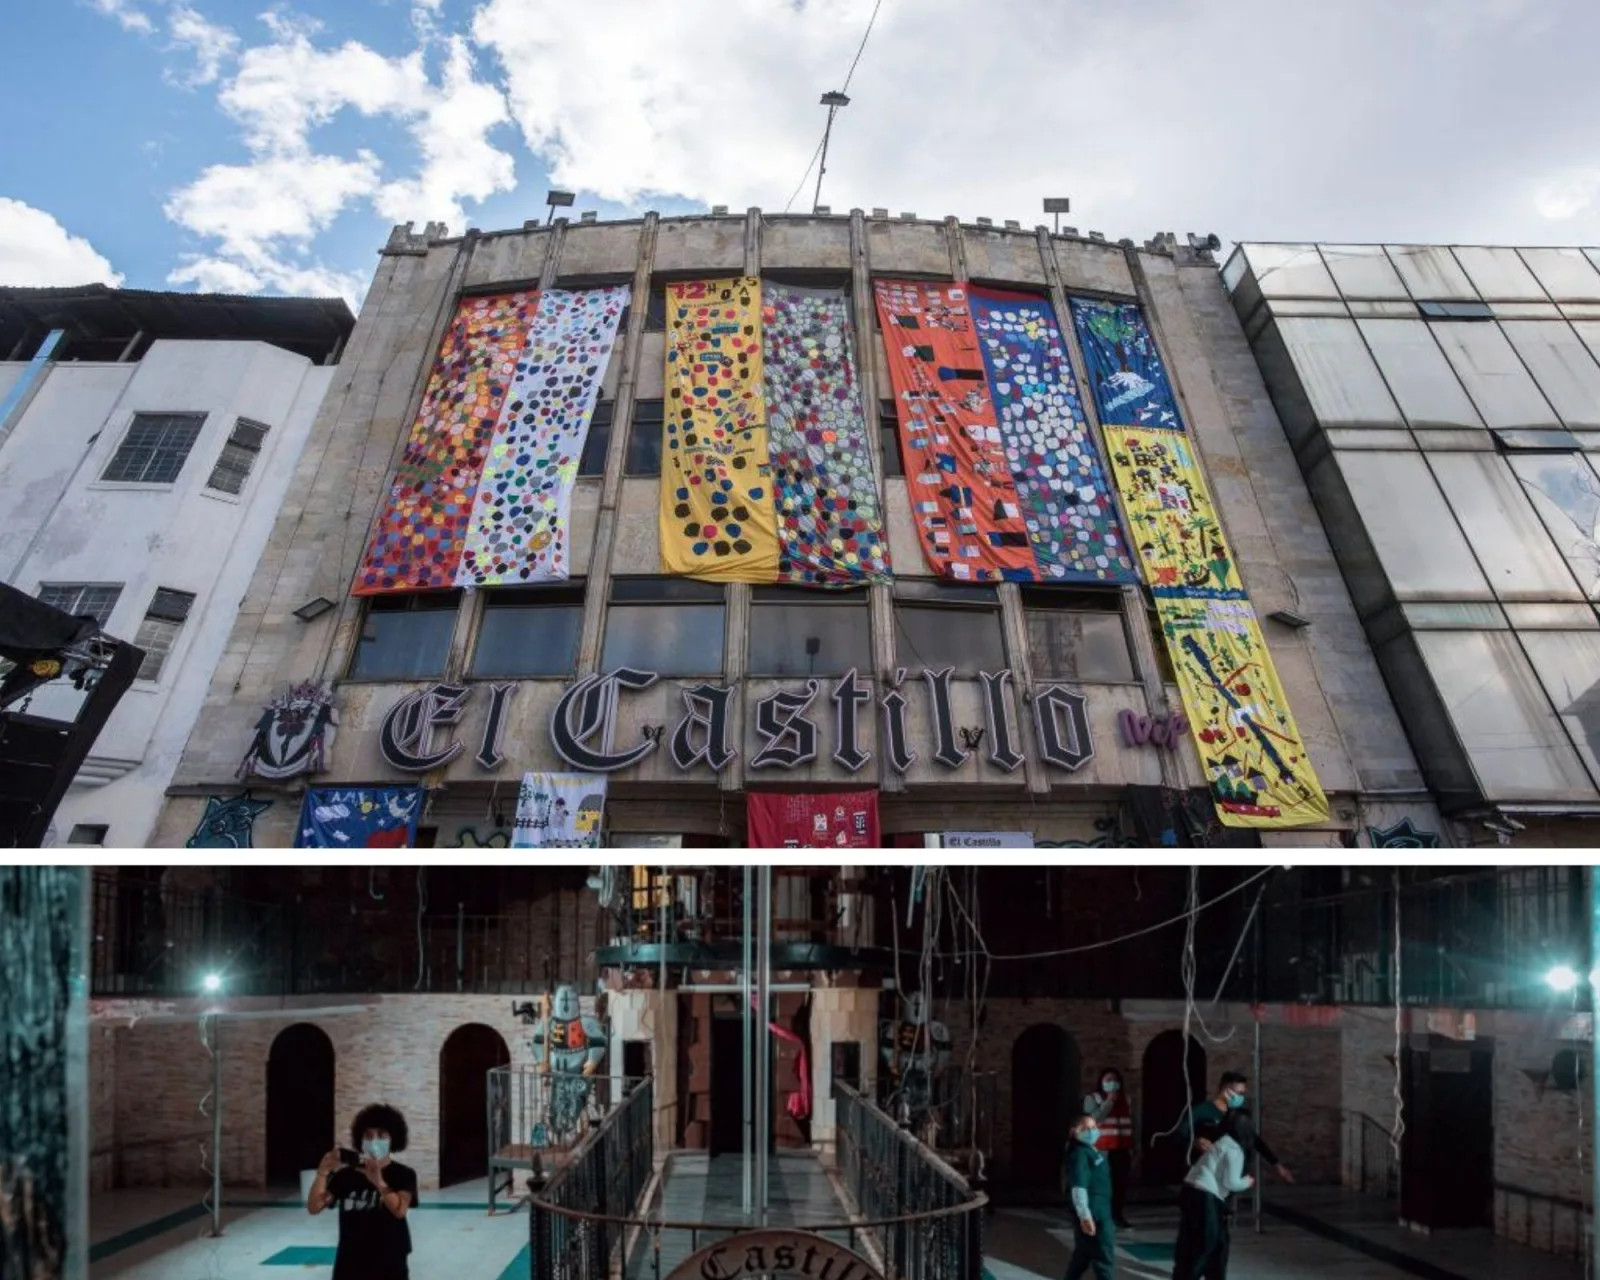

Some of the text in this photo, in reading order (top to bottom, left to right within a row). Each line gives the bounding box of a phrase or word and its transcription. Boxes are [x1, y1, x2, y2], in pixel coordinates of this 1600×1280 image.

[667, 282, 707, 299] 72
[379, 667, 1094, 772] El Castillo
